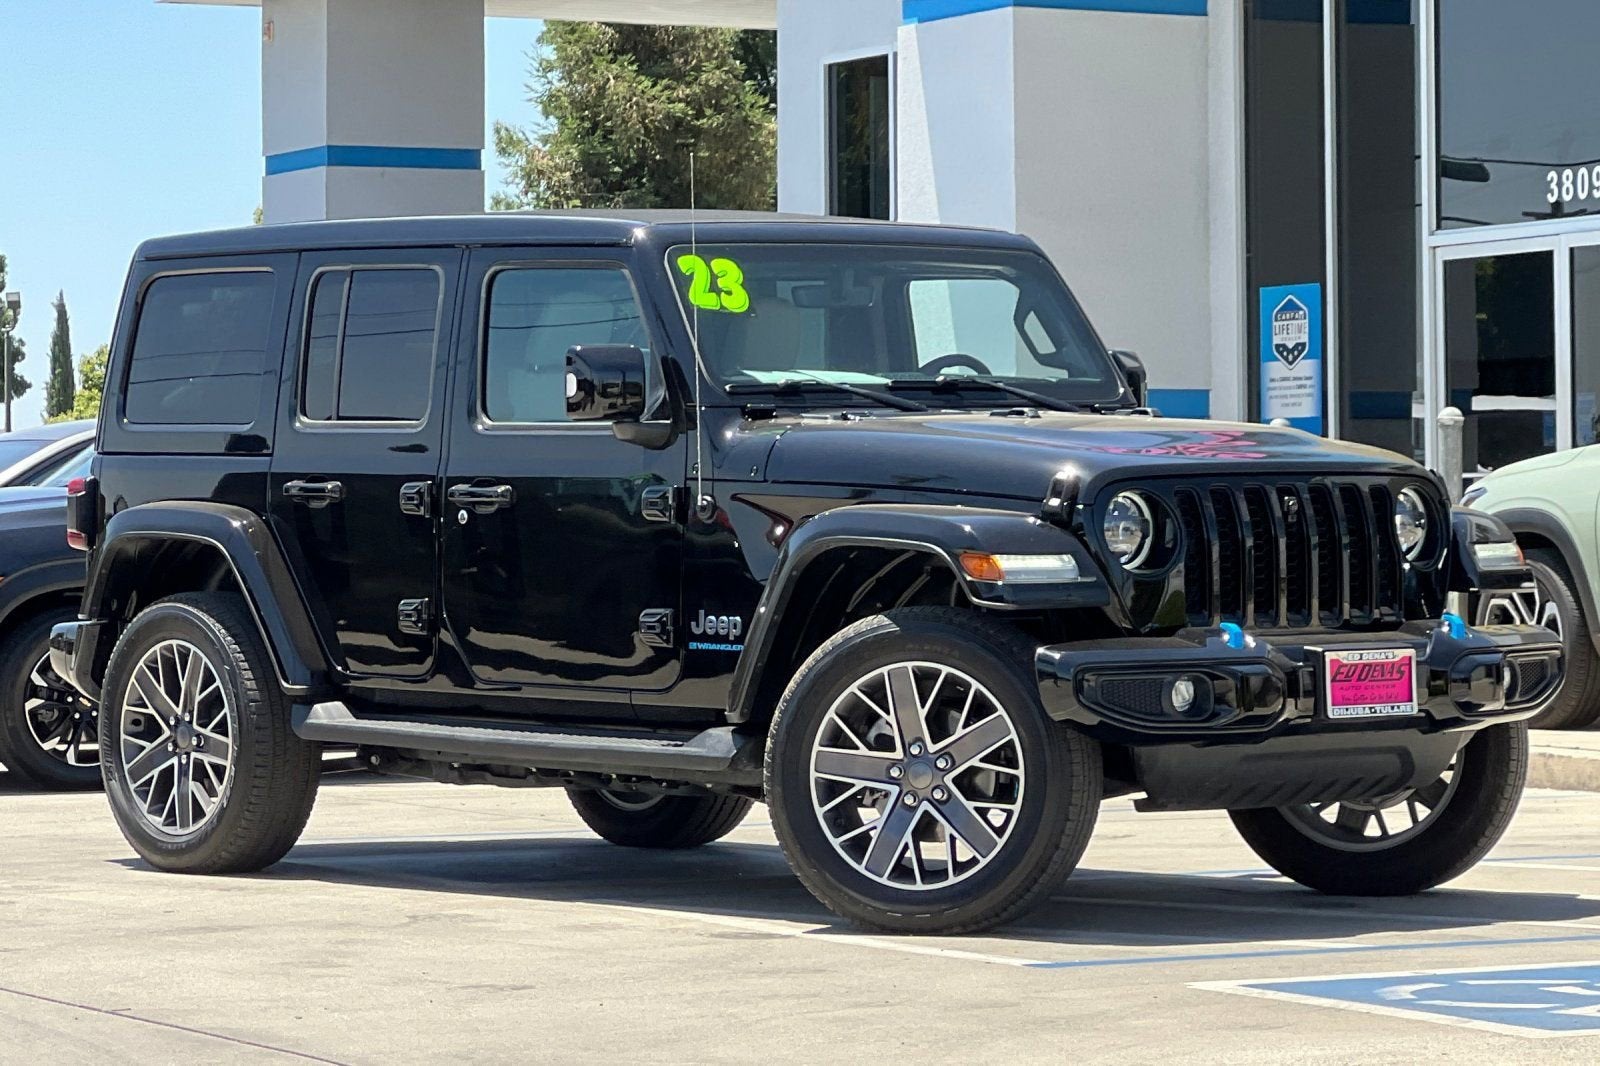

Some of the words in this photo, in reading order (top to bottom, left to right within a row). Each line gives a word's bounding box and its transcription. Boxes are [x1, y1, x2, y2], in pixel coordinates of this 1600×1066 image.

[1546, 165, 1600, 203] 3809
[677, 254, 750, 313] 23
[1274, 322, 1307, 336] LIFETIME
[690, 609, 742, 640] Jeep
[697, 642, 744, 650] WRANGLER
[1331, 663, 1358, 682] ED
[1375, 705, 1412, 713] TULARE
